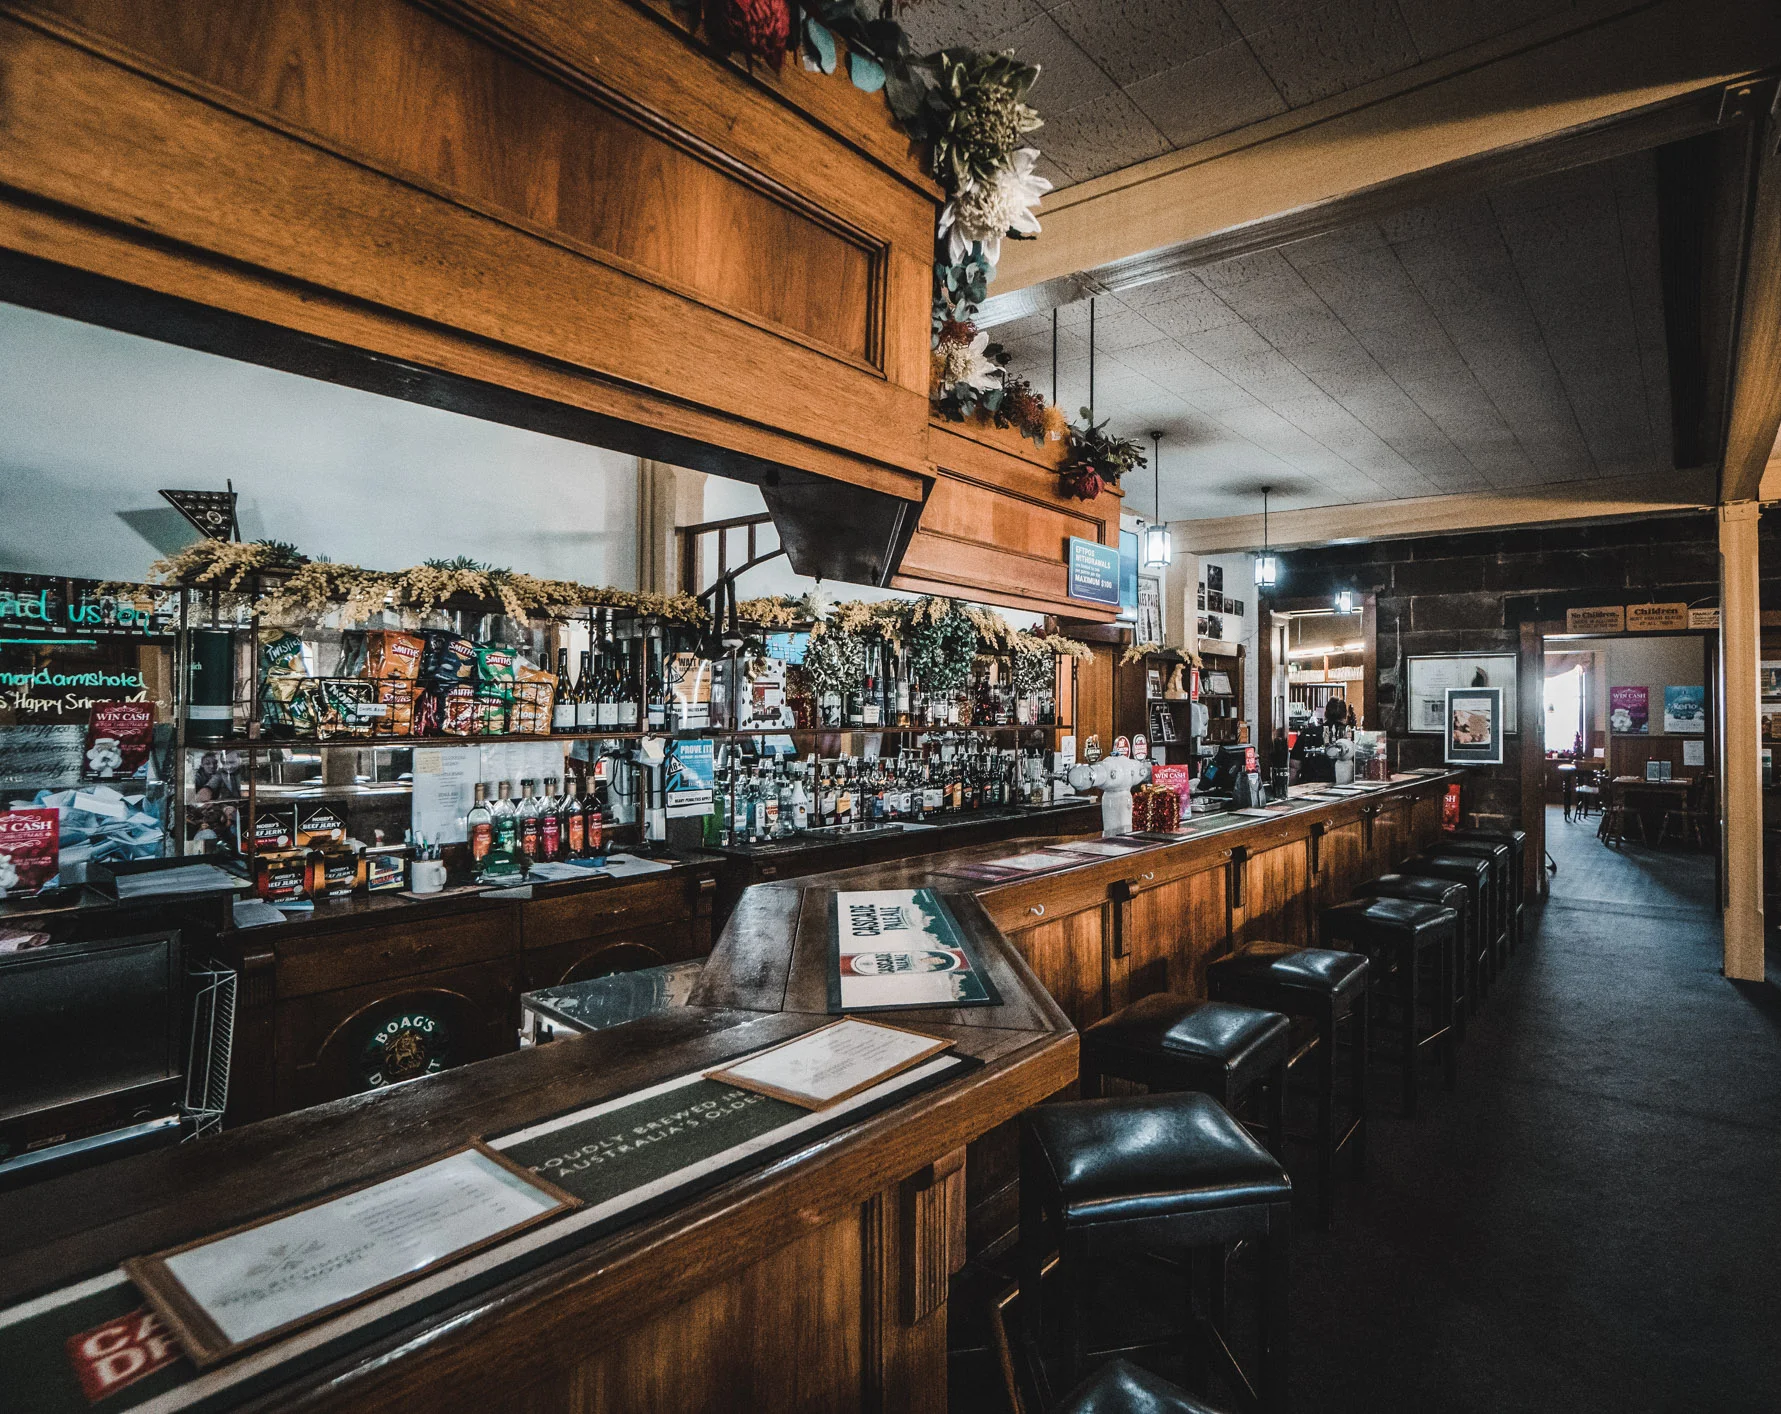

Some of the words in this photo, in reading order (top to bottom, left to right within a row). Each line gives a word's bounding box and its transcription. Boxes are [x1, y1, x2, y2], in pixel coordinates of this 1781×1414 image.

[69, 604, 101, 623] us
[1634, 608, 1678, 616] Children
[14, 691, 62, 714] Happy
[97, 713, 120, 721] WIN
[123, 713, 150, 721] CASH
[680, 745, 702, 755] PROVE
[11, 821, 53, 832] CASH
[850, 904, 881, 937] CASCADE
[375, 1016, 435, 1045] BOAG'S
[632, 1101, 717, 1135] BREWED
[723, 1089, 745, 1102] IN
[559, 1118, 699, 1178] AUSTRALIA'S
